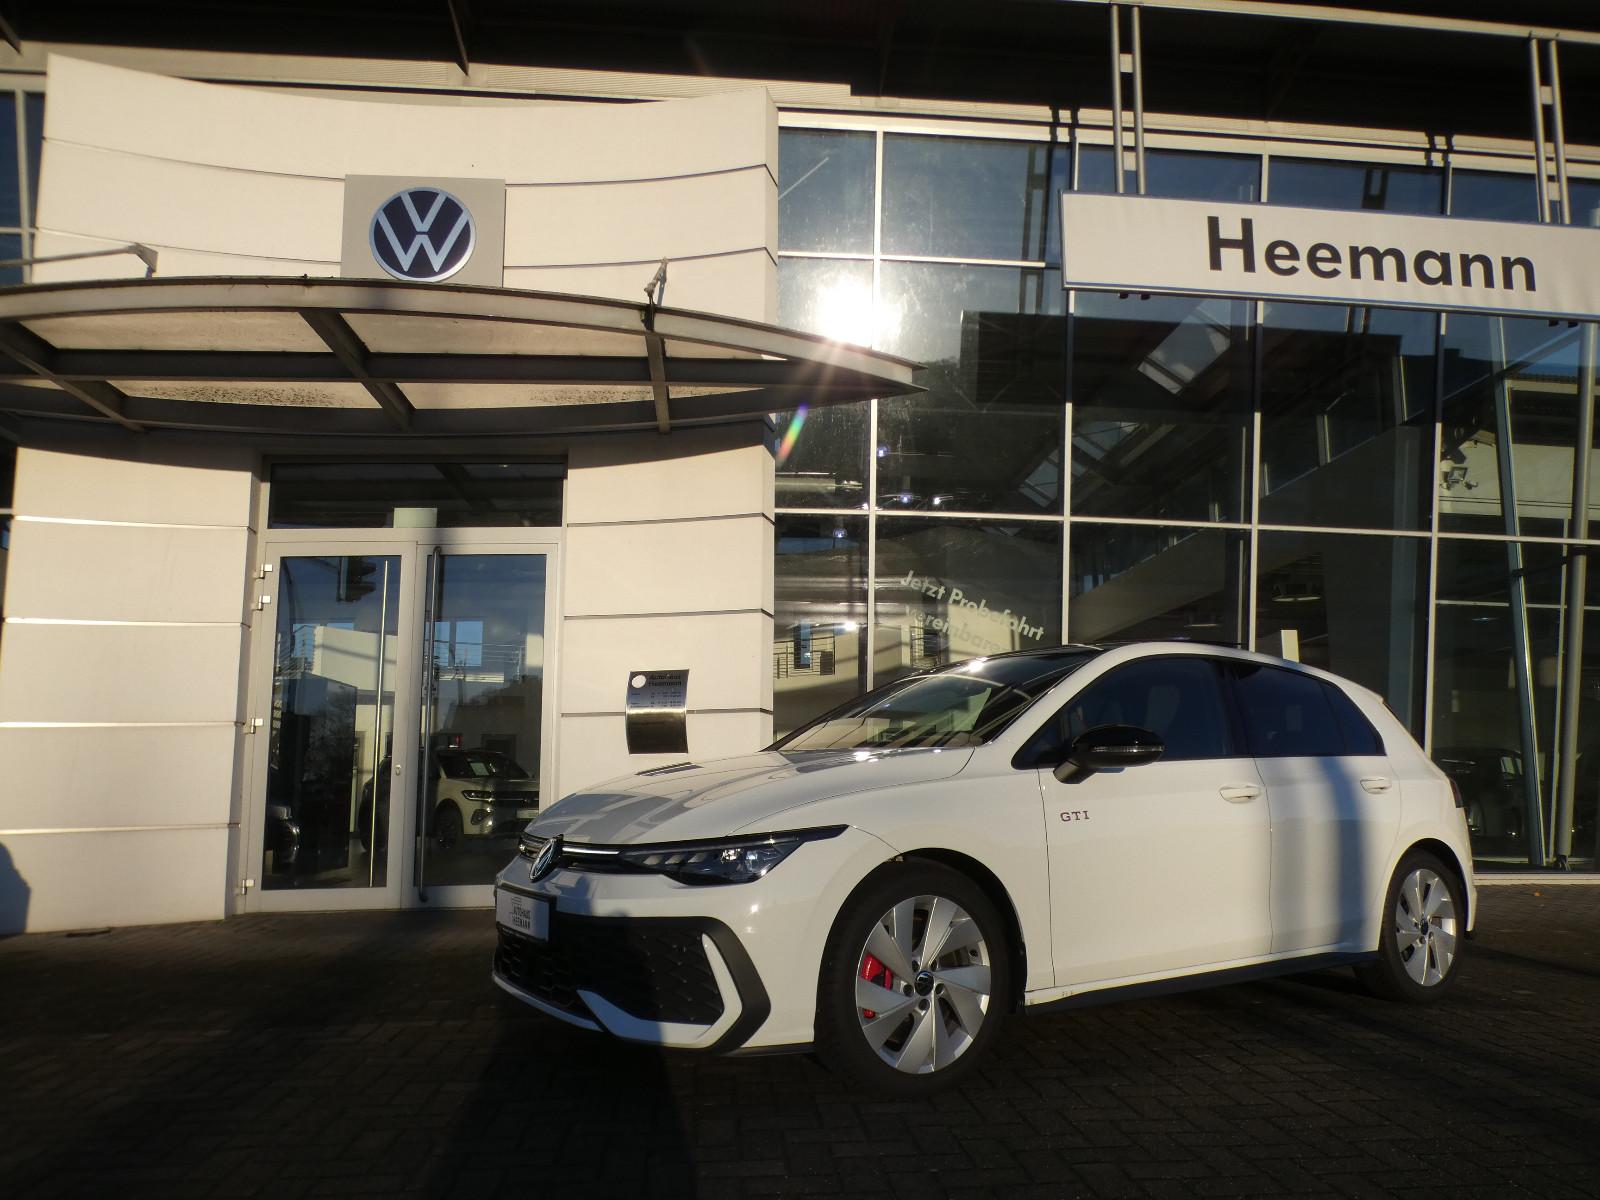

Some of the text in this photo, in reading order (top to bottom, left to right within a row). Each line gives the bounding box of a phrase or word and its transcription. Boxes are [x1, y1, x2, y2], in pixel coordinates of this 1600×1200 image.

[371, 188, 475, 280] VW
[1206, 215, 1537, 293] Heemann
[900, 569, 1044, 641] Jetzt Probefahrt
[1060, 810, 1090, 822] GTI
